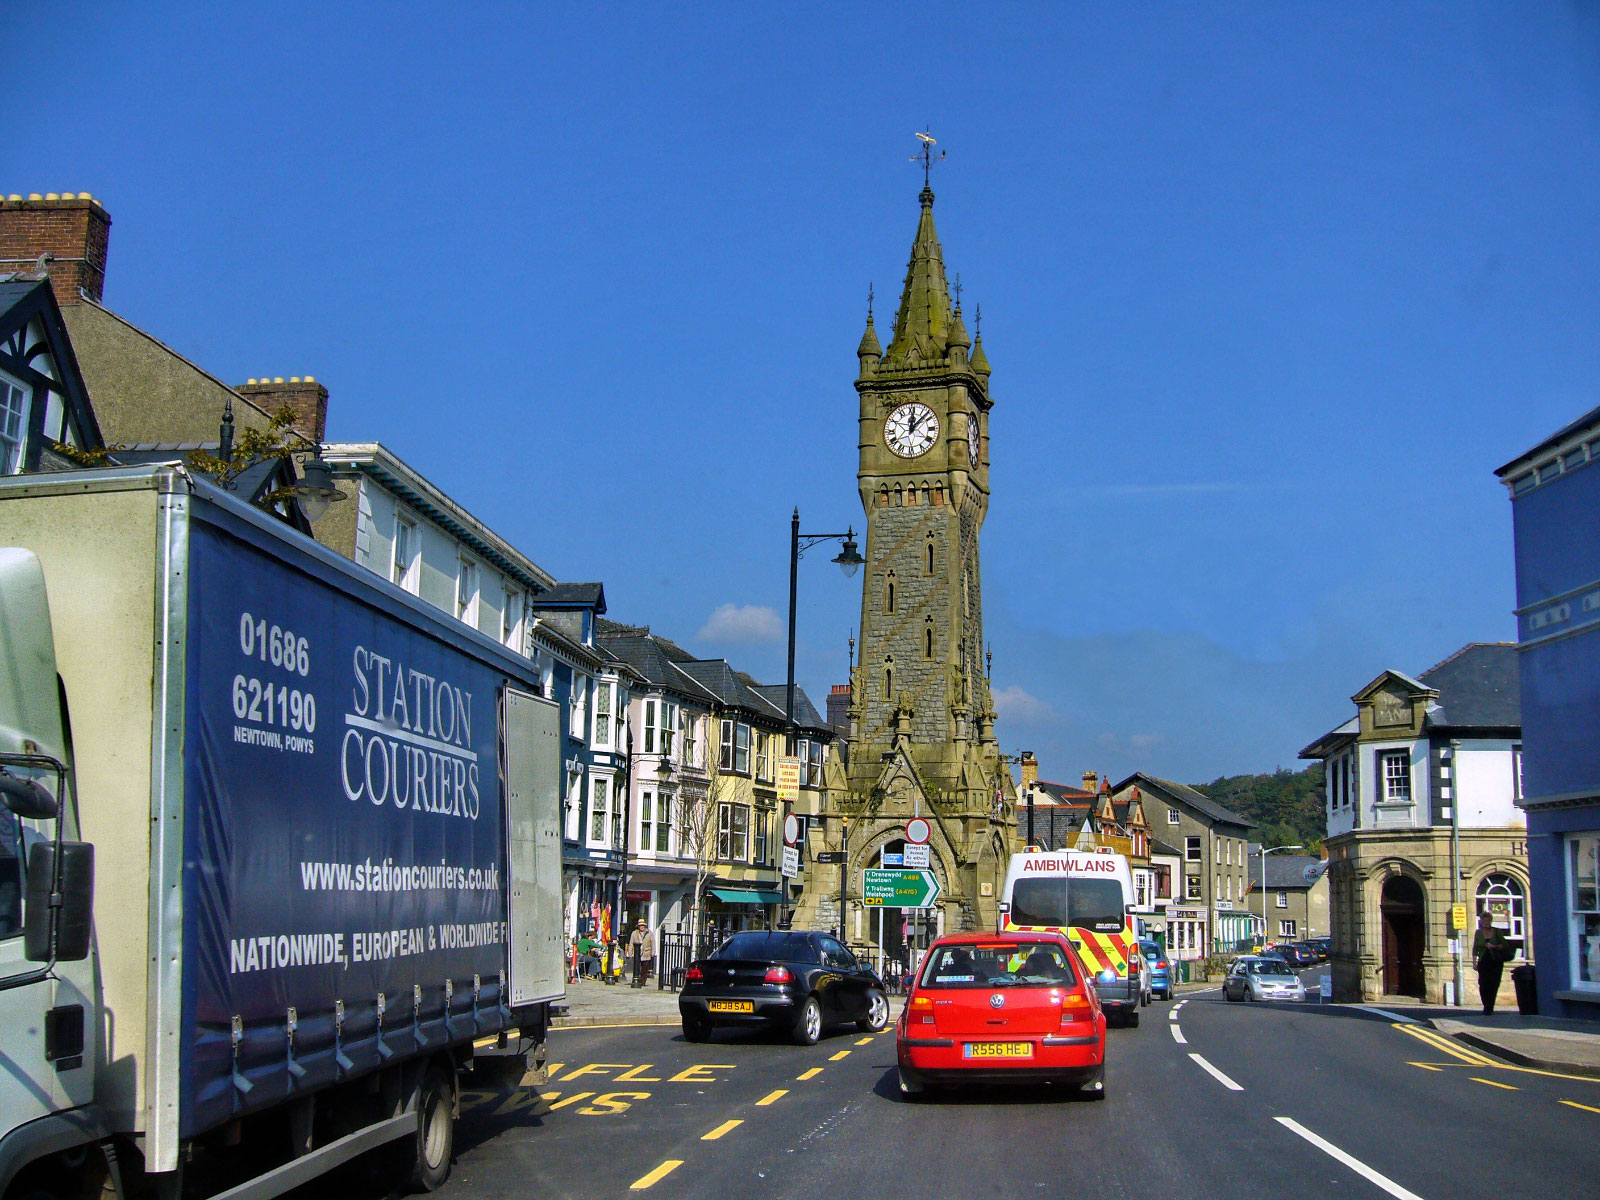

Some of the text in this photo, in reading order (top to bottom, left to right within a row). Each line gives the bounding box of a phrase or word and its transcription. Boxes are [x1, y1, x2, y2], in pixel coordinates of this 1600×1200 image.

[240, 612, 310, 677] 01686
[232, 674, 316, 733] 621190
[352, 645, 472, 748] STATION
[233, 726, 314, 754] NEWTOWN, POWYS
[341, 729, 479, 821] COURIERS
[300, 857, 499, 892] www.stationcouriers.co.uk
[871, 871, 902, 879] Drenewydd
[1023, 859, 1116, 873] AMBIWLANS
[896, 888, 918, 896] (A470)
[230, 932, 349, 974] NATIONWIDE,
[353, 927, 424, 962] EUROPEAN
[428, 924, 436, 949] &
[440, 921, 499, 949] WORLDWIDE
[735, 1002, 751, 1011] SAJ
[972, 1043, 1030, 1056] R556 HEJ
